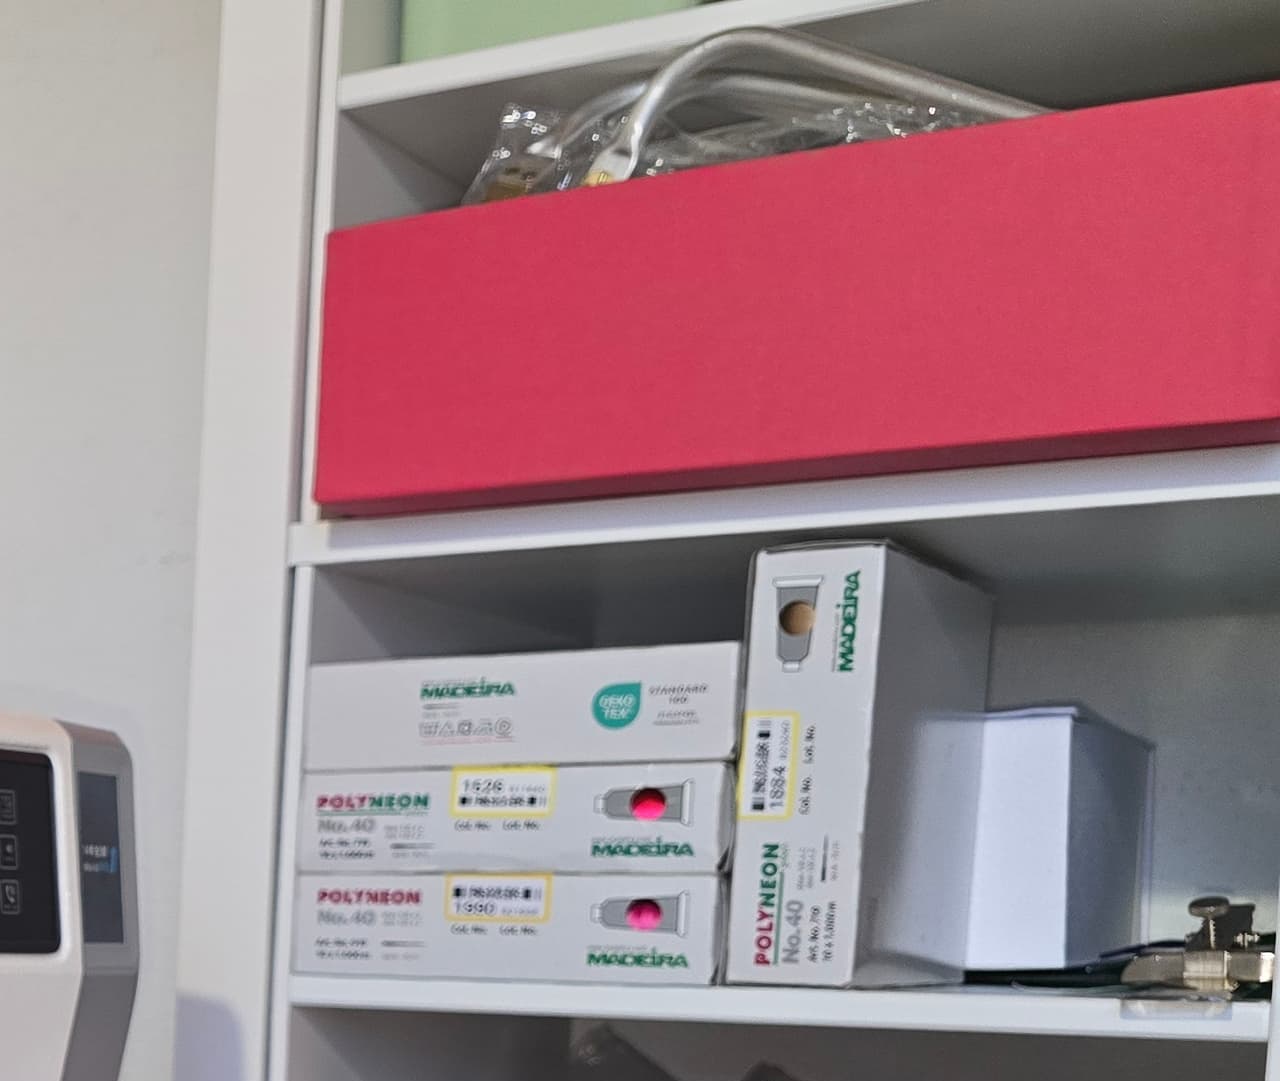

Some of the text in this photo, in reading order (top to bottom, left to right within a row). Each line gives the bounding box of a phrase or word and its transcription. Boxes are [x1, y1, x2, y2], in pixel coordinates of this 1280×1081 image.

[317, 793, 430, 809] POLYNEON
[317, 888, 422, 905] POLYNEON
[754, 843, 780, 966] POLYNEON
